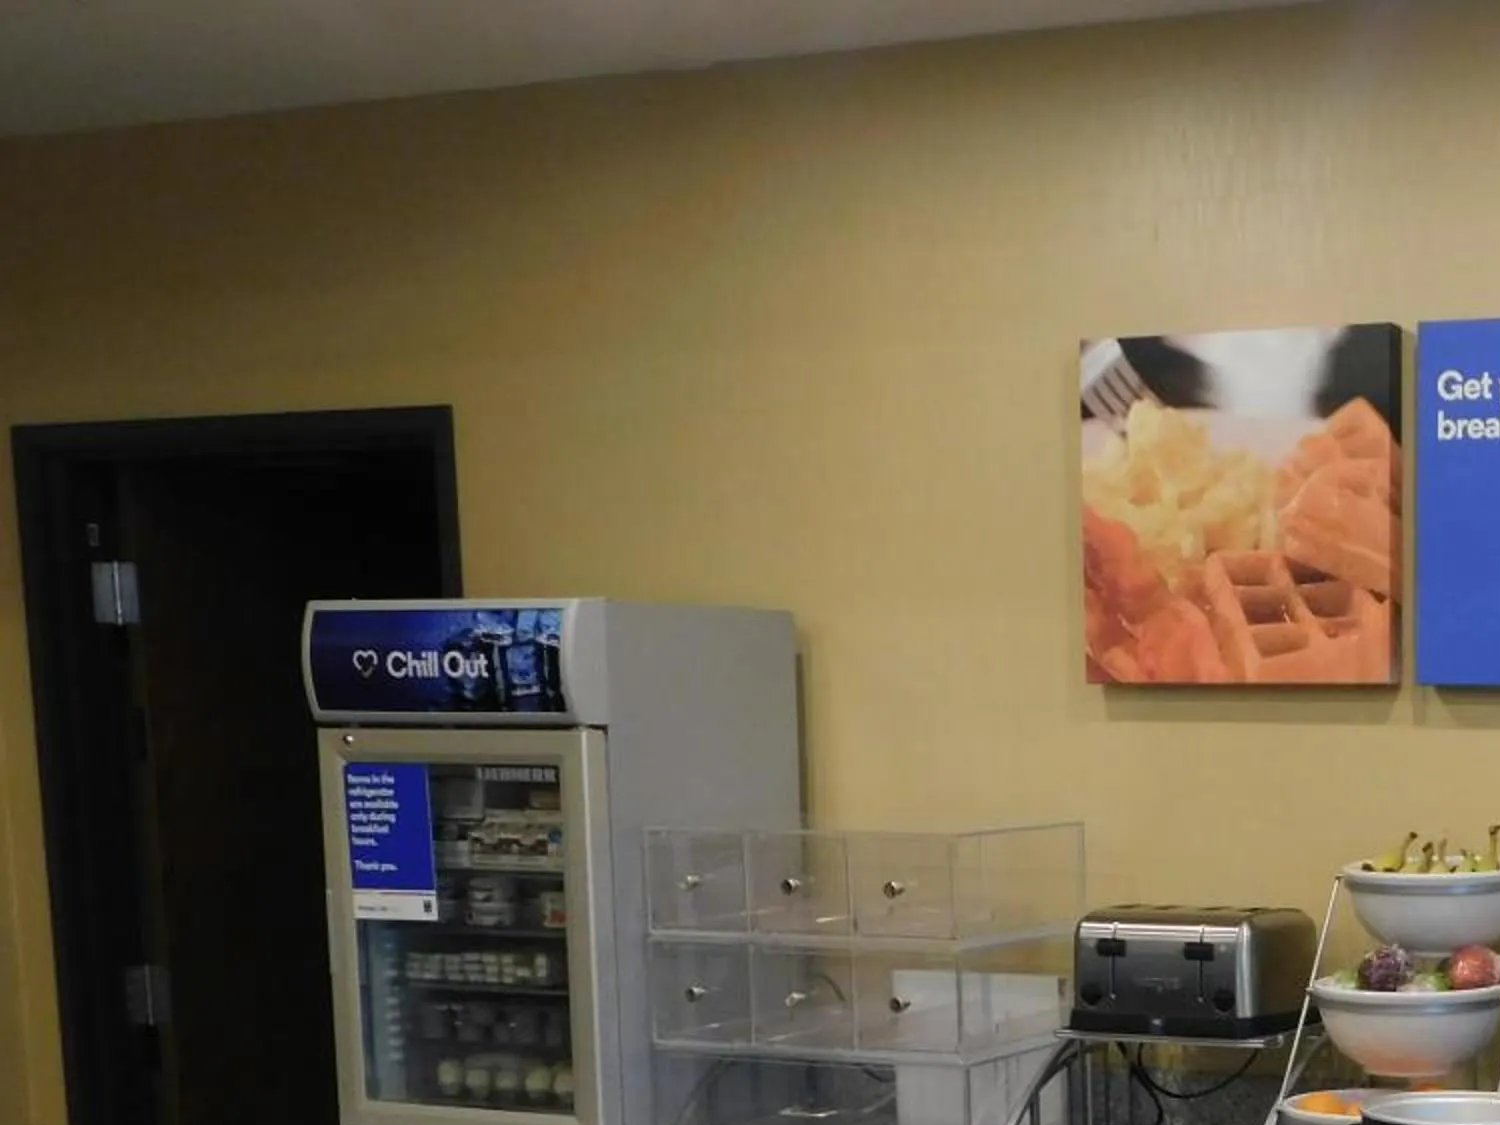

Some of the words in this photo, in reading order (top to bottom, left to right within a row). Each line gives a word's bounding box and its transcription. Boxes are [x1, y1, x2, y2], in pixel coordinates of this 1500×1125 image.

[1437, 369, 1493, 401] Get
[386, 650, 440, 678] Chill
[443, 650, 489, 678] Out
